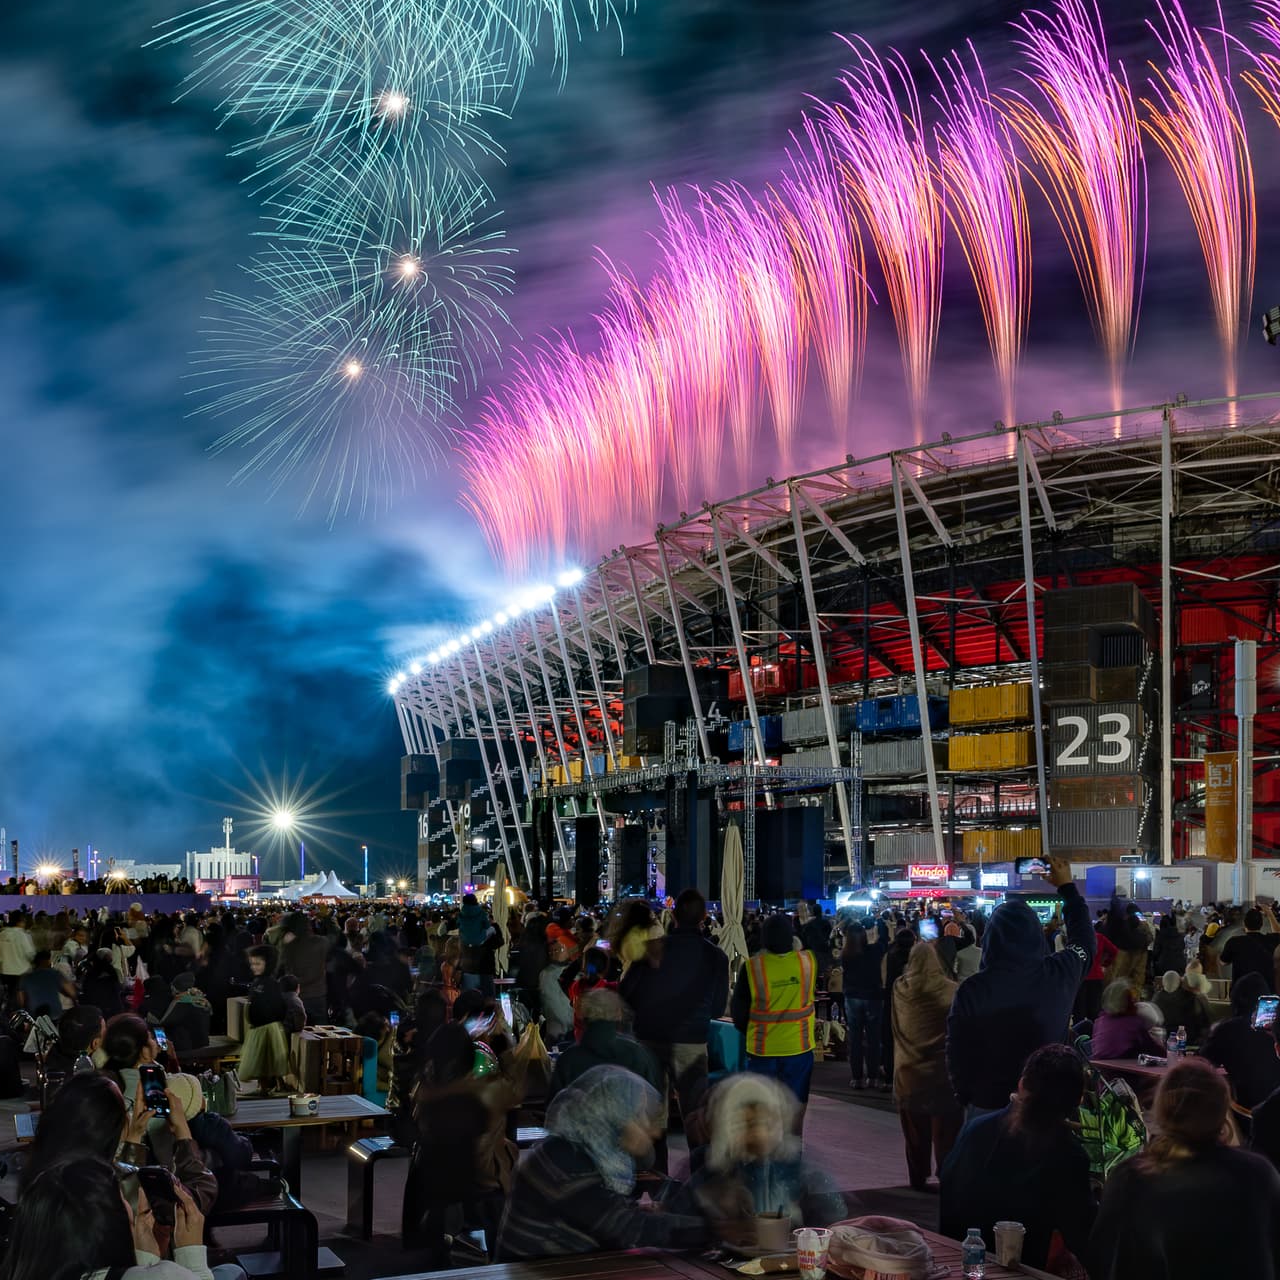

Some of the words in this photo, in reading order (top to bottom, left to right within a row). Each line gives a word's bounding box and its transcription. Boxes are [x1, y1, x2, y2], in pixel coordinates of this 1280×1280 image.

[1056, 713, 1131, 766] 23
[418, 813, 429, 839] 16
[442, 845, 459, 857] L2
[911, 865, 947, 877] Nando's
